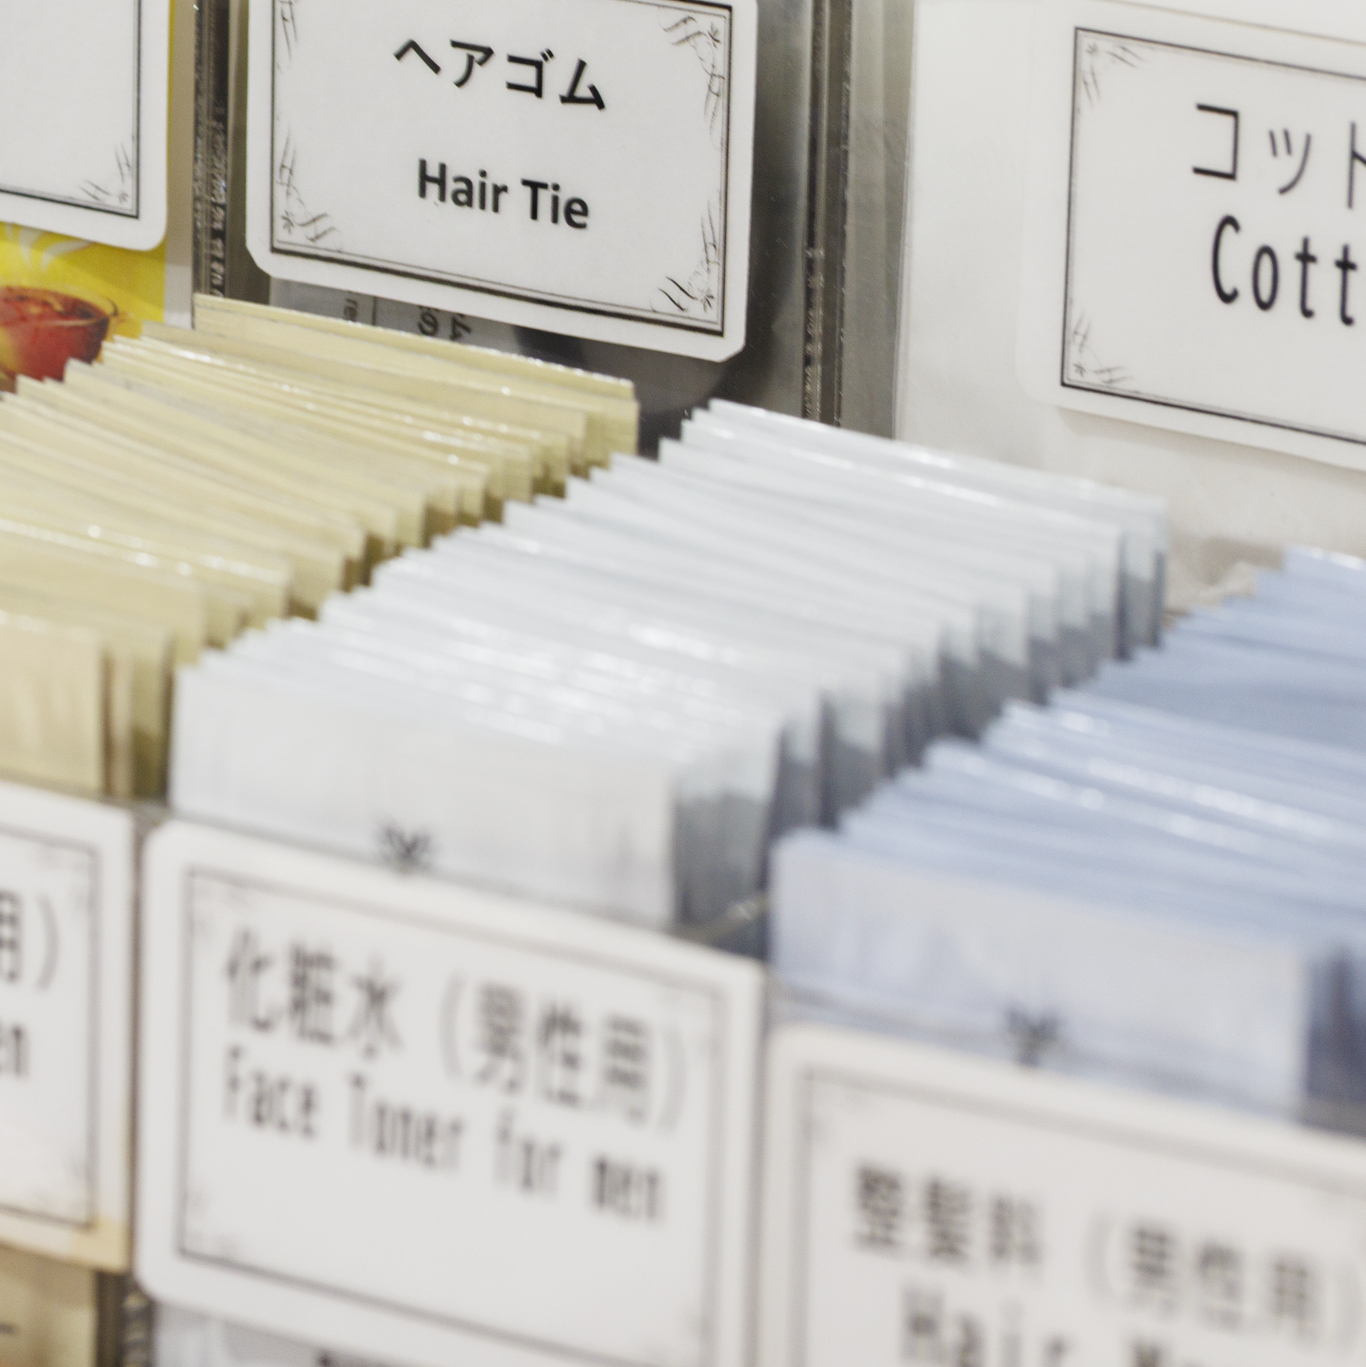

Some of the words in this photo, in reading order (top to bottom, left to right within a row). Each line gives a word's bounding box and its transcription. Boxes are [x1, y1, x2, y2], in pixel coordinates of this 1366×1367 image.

[393, 37, 607, 112] ヘアゴム
[418, 158, 509, 215] Hair
[521, 176, 590, 231] Tie
[1212, 214, 1358, 326] Cott
[224, 1045, 317, 1141] Face
